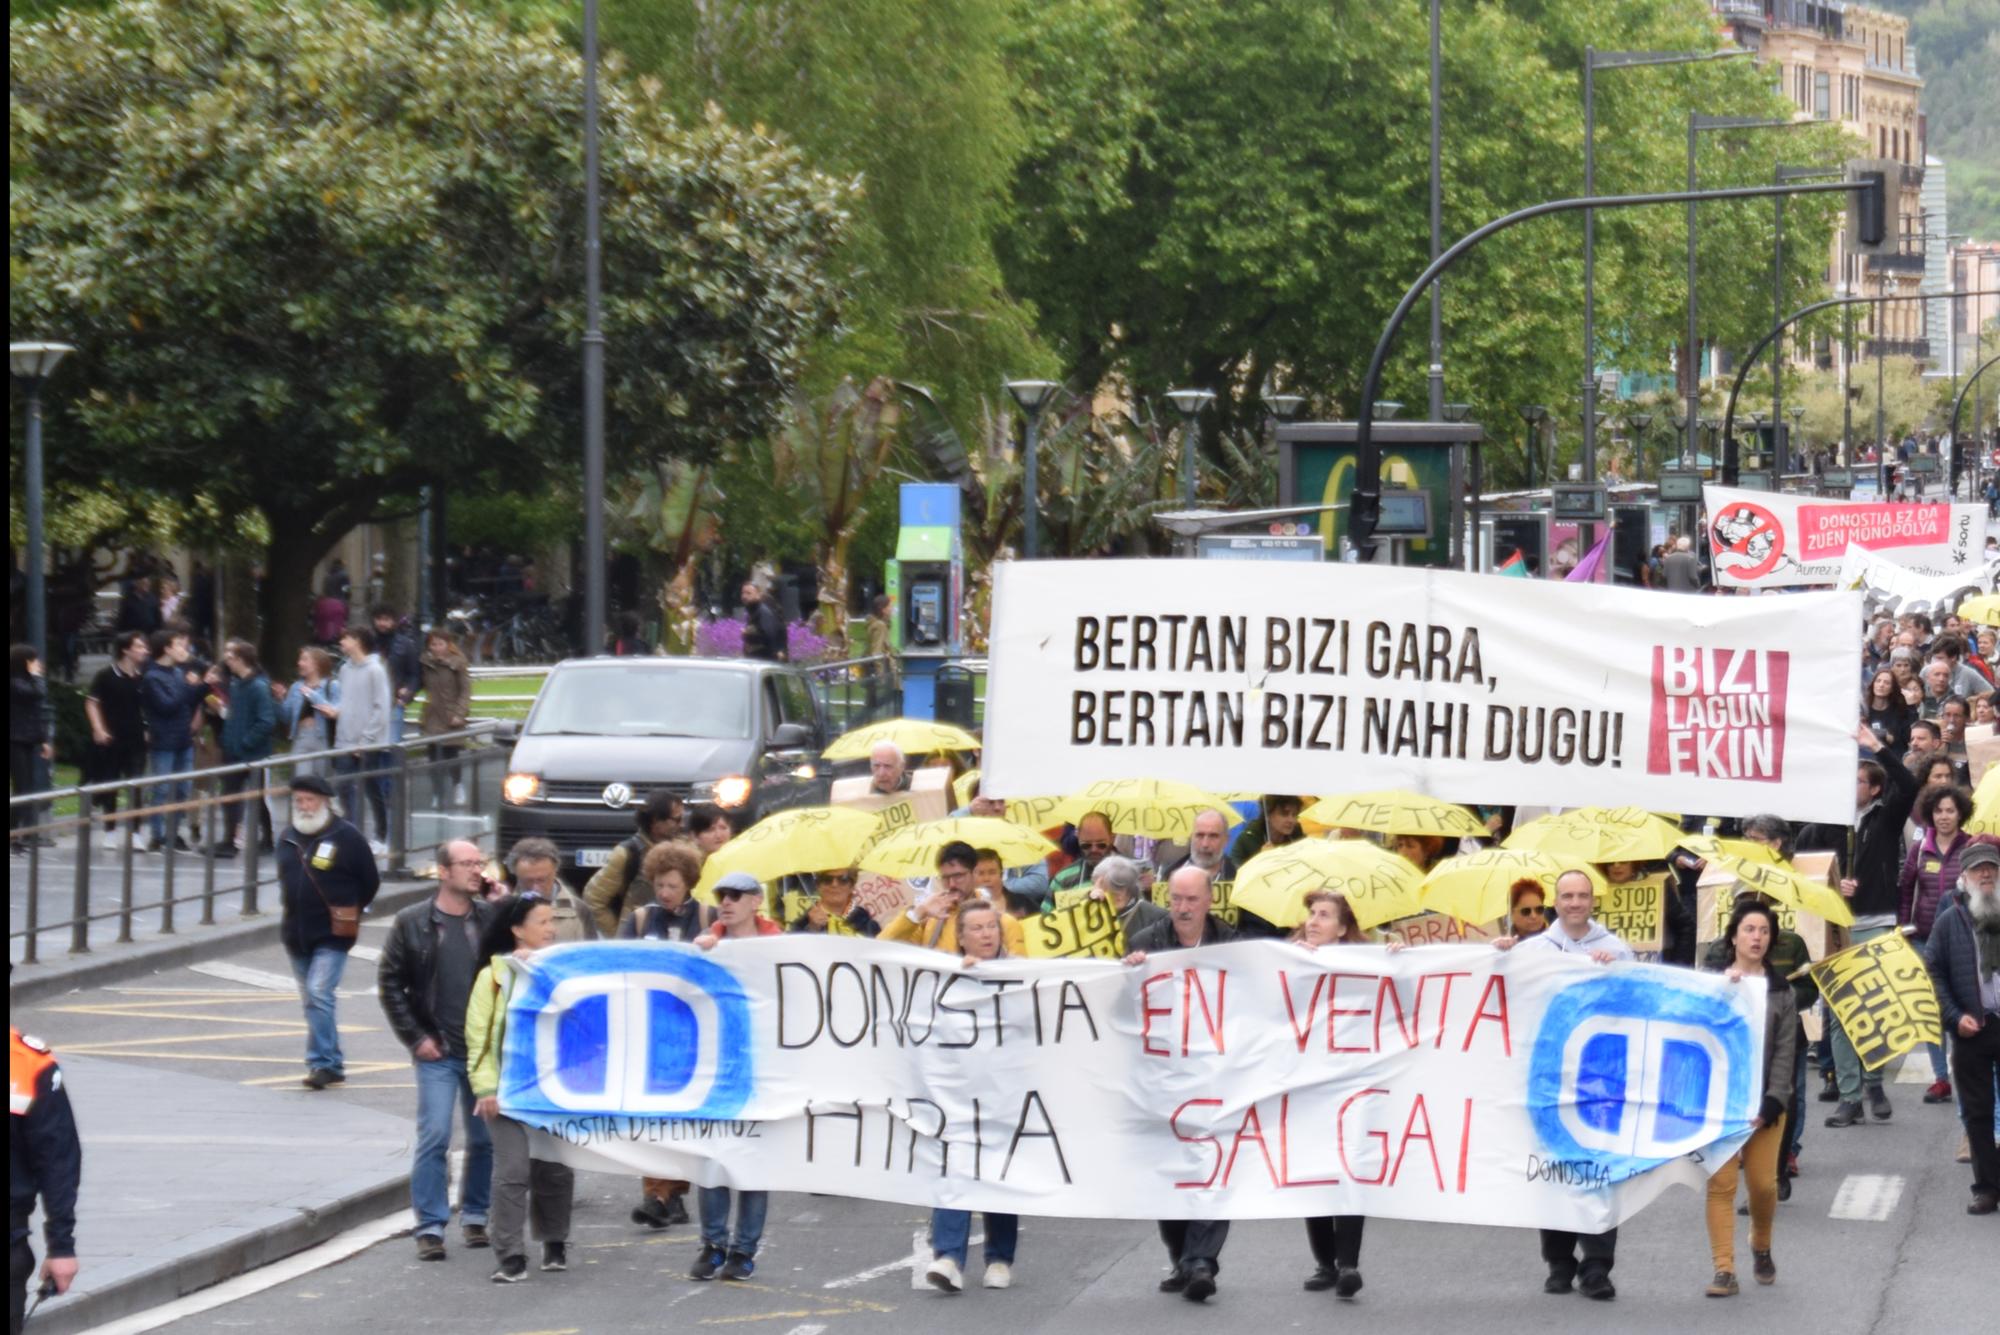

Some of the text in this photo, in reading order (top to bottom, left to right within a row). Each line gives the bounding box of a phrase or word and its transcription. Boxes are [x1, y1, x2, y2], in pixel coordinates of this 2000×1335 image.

[1808, 522, 1938, 551] ZUEN MONOPOLYA
[1819, 506, 1938, 531] DONOSTIA EZ DA
[1958, 514, 1971, 548] sortu
[1074, 615, 1498, 692] BERTAN BIZI GARA,
[1663, 647, 1769, 697] BIZI
[1070, 690, 1624, 769] BERTAN BIZI NAHI DUGU!
[1667, 693, 1771, 731] LAGUN
[1667, 728, 1774, 779] EKIN
[1613, 886, 1656, 911] STOP
[775, 961, 1512, 1058] DONOSTIA EN VENTA
[803, 1088, 1474, 1195] HIRIA SALGAI
